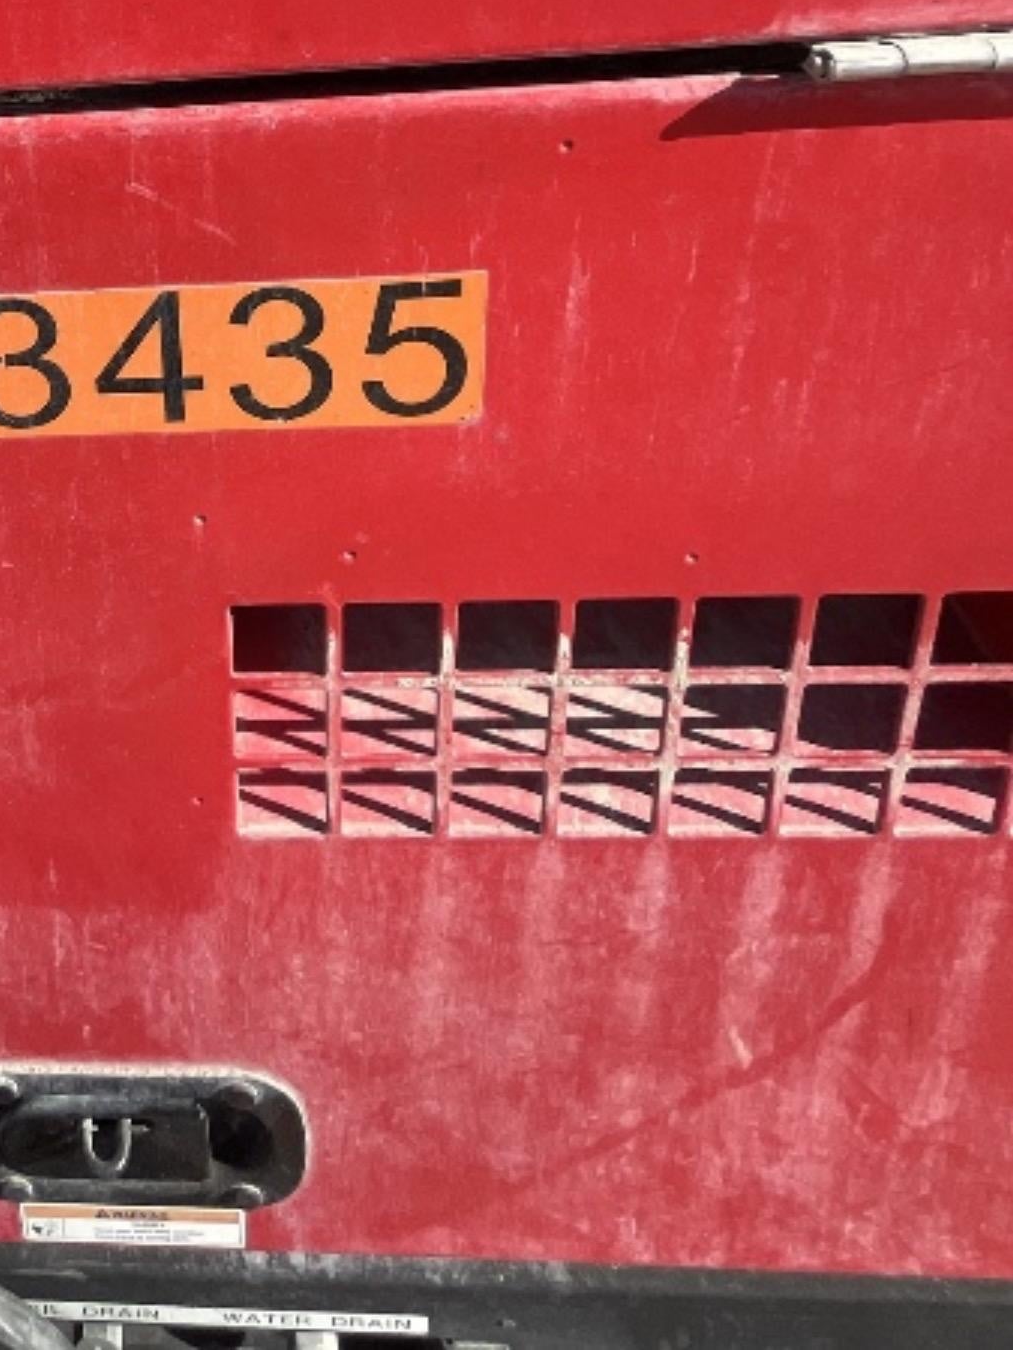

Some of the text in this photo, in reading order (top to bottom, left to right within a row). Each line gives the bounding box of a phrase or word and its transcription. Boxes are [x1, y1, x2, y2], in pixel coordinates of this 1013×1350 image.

[82, 1306, 160, 1320] DRAIN
[223, 1312, 412, 1330] WATER DRAIN
